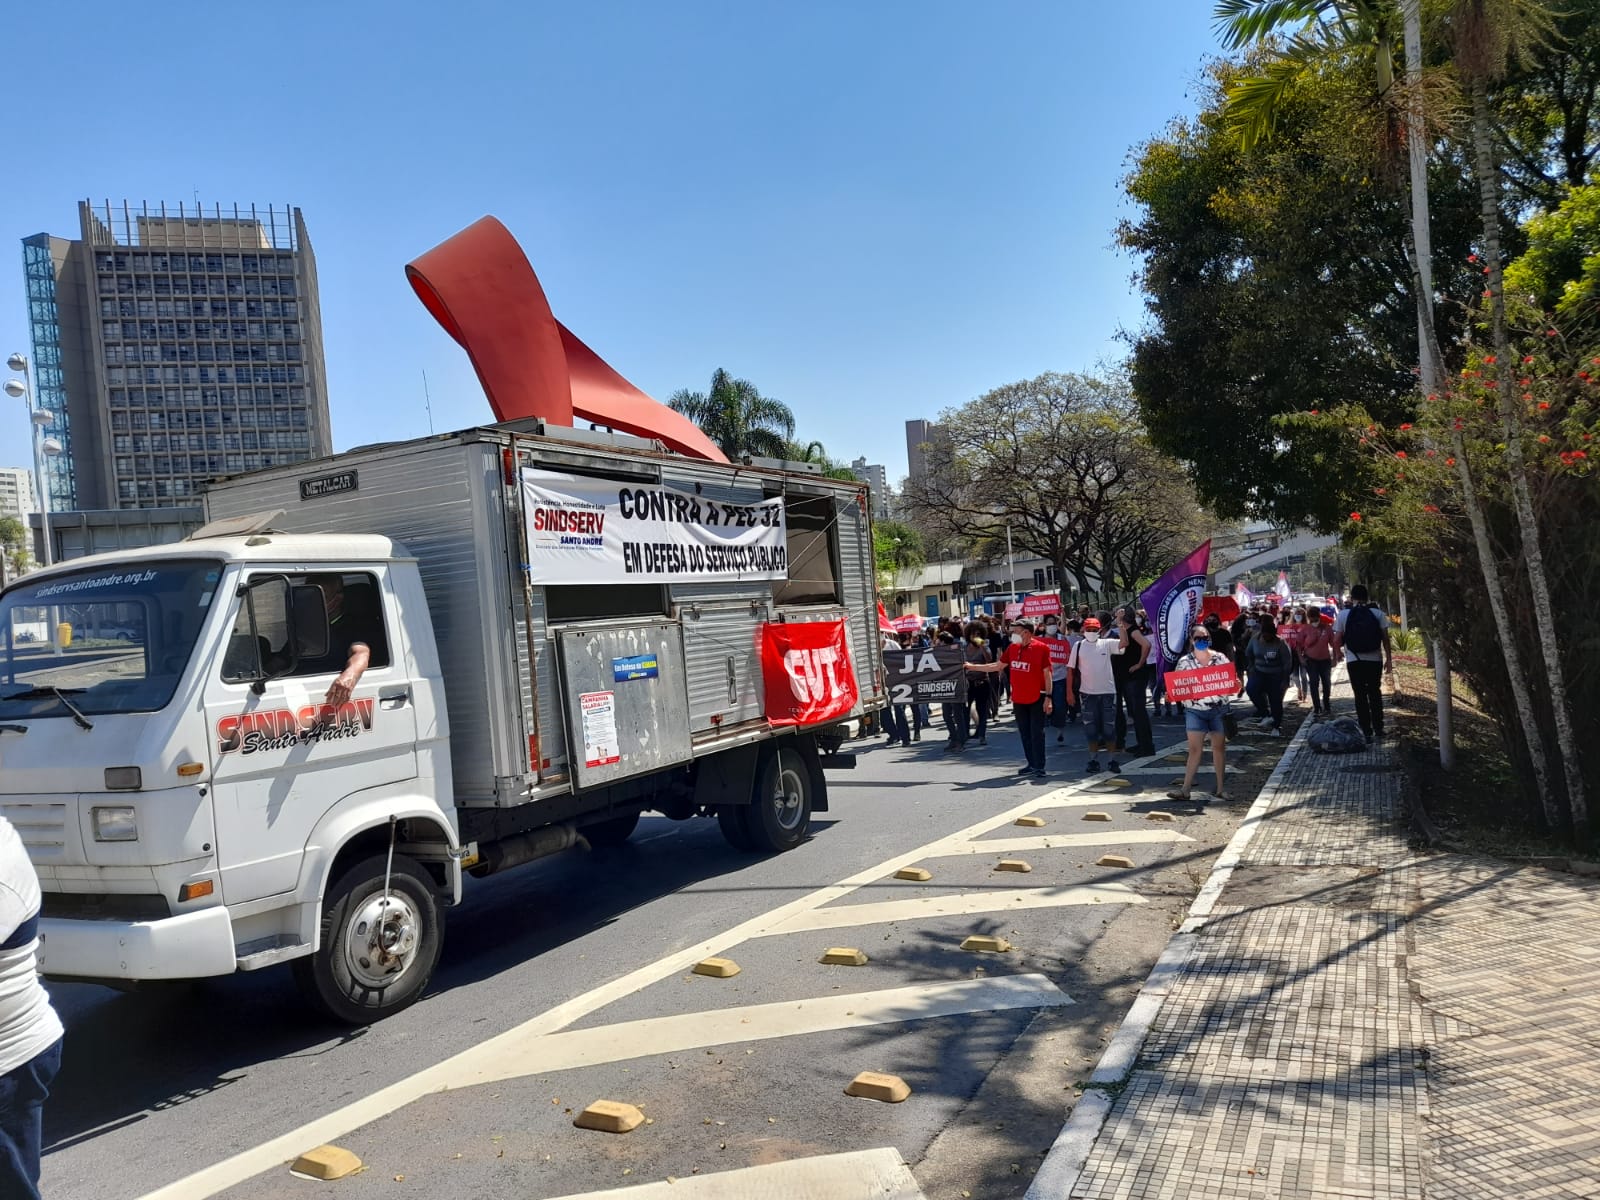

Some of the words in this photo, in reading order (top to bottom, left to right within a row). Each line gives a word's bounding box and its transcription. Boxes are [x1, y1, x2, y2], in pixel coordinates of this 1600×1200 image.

[304, 475, 351, 496] METALCAR
[533, 507, 605, 534] SINDSERV
[618, 488, 701, 524] CONTRA
[706, 502, 719, 526] A
[722, 504, 757, 527] PEC
[761, 503, 782, 527] 32
[560, 536, 581, 545] SANTO
[582, 536, 603, 546] ANDRÉ
[623, 542, 643, 573] EM
[644, 542, 687, 573] DEFESA
[689, 544, 705, 573] DO
[706, 545, 748, 579] SERVIÇO
[749, 538, 786, 571] PÚBLICO
[35, 569, 158, 599] sindservsantoandre.org.br
[1160, 589, 1178, 622] RESPEITO
[784, 646, 844, 703] CUT
[898, 648, 942, 674] JÁ
[1011, 660, 1028, 670] CUT
[918, 681, 957, 693] SINDSERV
[1171, 686, 1190, 697] FORA
[1192, 679, 1234, 694] BOLSONARO
[1173, 676, 1200, 687] VACINA,
[1202, 670, 1229, 683] AUXÍLIO
[216, 697, 374, 754] SINDSERV
[242, 731, 298, 755] Santo
[304, 719, 360, 746] André
